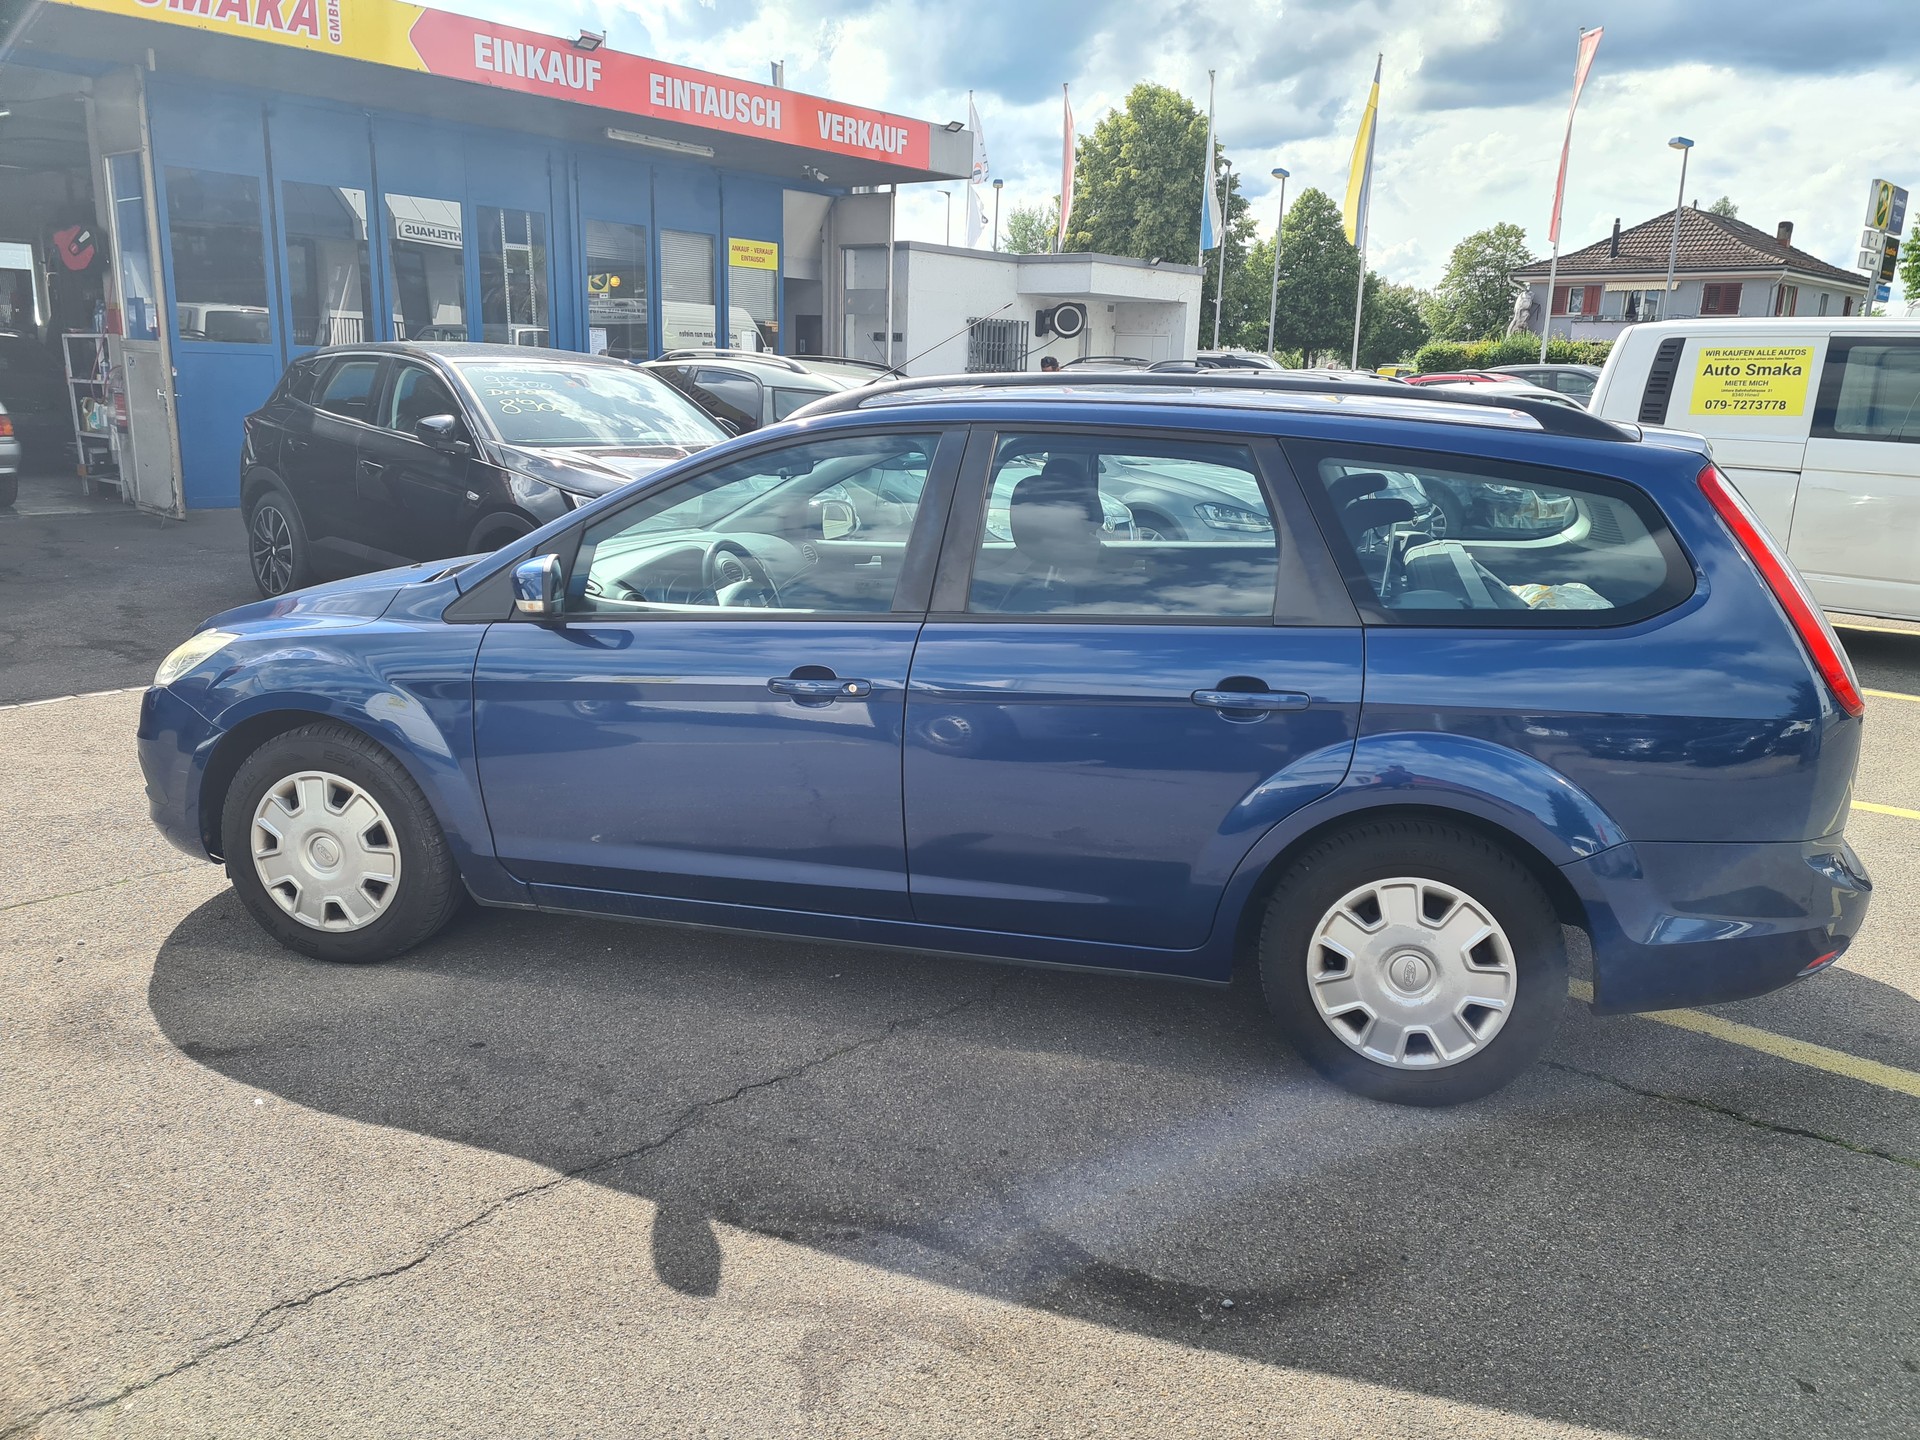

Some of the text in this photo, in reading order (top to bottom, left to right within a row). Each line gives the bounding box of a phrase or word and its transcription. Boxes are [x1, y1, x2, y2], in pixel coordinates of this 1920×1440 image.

[474, 33, 908, 154] EINKAUF EINTAUSCH VERKAUF
[731, 245, 750, 253] ANKAUF
[754, 247, 774, 255] VERKAUF
[740, 255, 766, 263] EINTAUSCH
[1722, 349, 1755, 357] KAUFEN
[1778, 348, 1806, 356] AUTOS
[1702, 362, 1802, 376] Auto Smaka
[1704, 400, 1787, 410] 079-7273778
